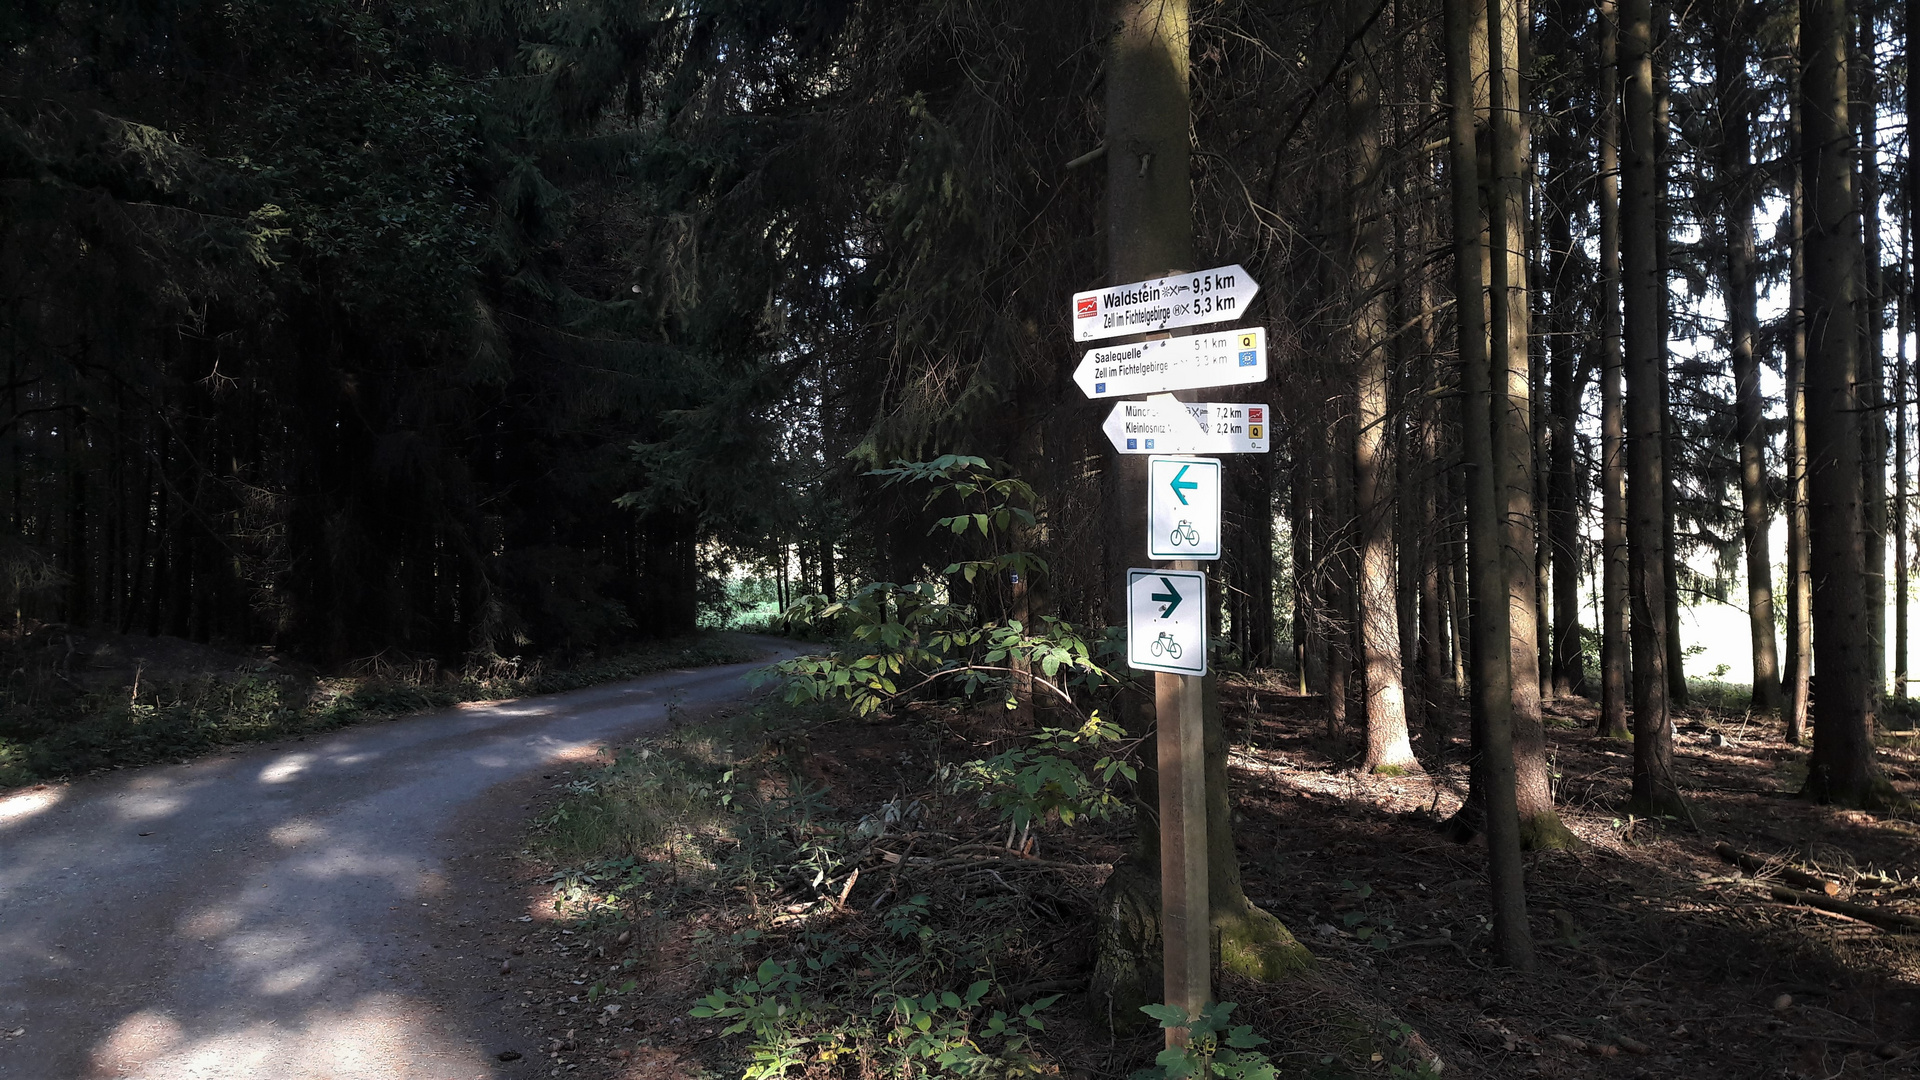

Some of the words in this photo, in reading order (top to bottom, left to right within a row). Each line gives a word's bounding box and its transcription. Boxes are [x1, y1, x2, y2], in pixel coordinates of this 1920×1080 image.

[1103, 286, 1161, 309] Waldstein
[1192, 278, 1212, 296] 9,5
[1215, 274, 1235, 291] km
[1103, 313, 1116, 329] Zell
[1116, 311, 1125, 326] im
[1125, 306, 1171, 326] Fichtelgebirge
[1193, 299, 1212, 317] 5,3
[1215, 295, 1236, 311] km
[1242, 337, 1251, 347] Q
[1095, 347, 1142, 364] Saalequelle
[1212, 337, 1227, 349] km
[1095, 367, 1108, 379] Zell
[1108, 366, 1118, 378] im
[1119, 361, 1169, 376] Fichtelgebirge
[1217, 407, 1228, 419] 7,2
[1230, 407, 1242, 418] km
[1217, 423, 1229, 435] 2,2
[1230, 423, 1242, 434] km
[1252, 427, 1259, 437] Q
